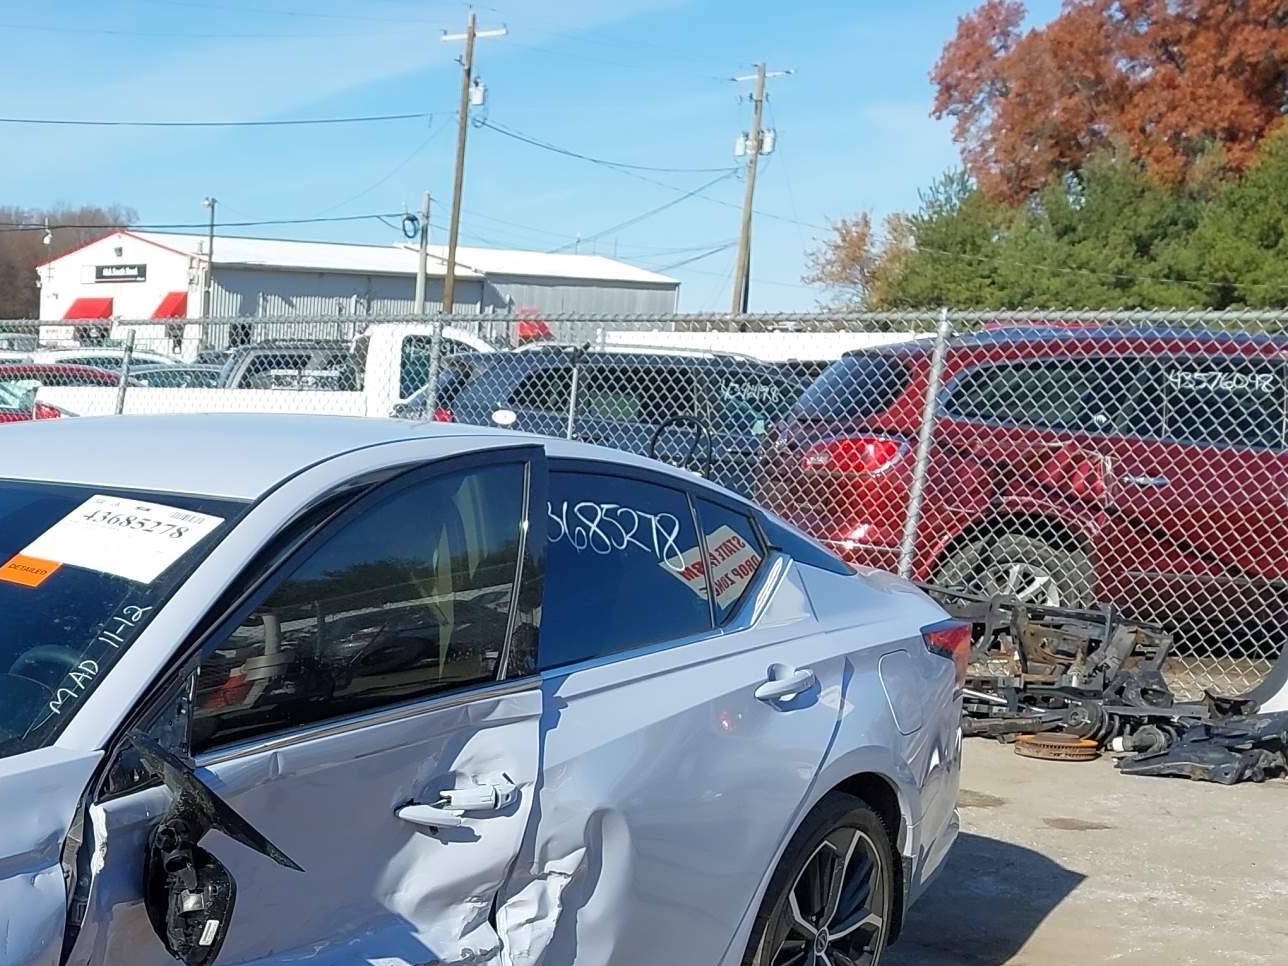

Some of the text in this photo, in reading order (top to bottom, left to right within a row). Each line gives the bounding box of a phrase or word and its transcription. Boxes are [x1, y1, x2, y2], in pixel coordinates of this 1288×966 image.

[84, 510, 190, 539] 43685278
[8, 563, 48, 576] DETAILED
[49, 659, 99, 714] MAD
